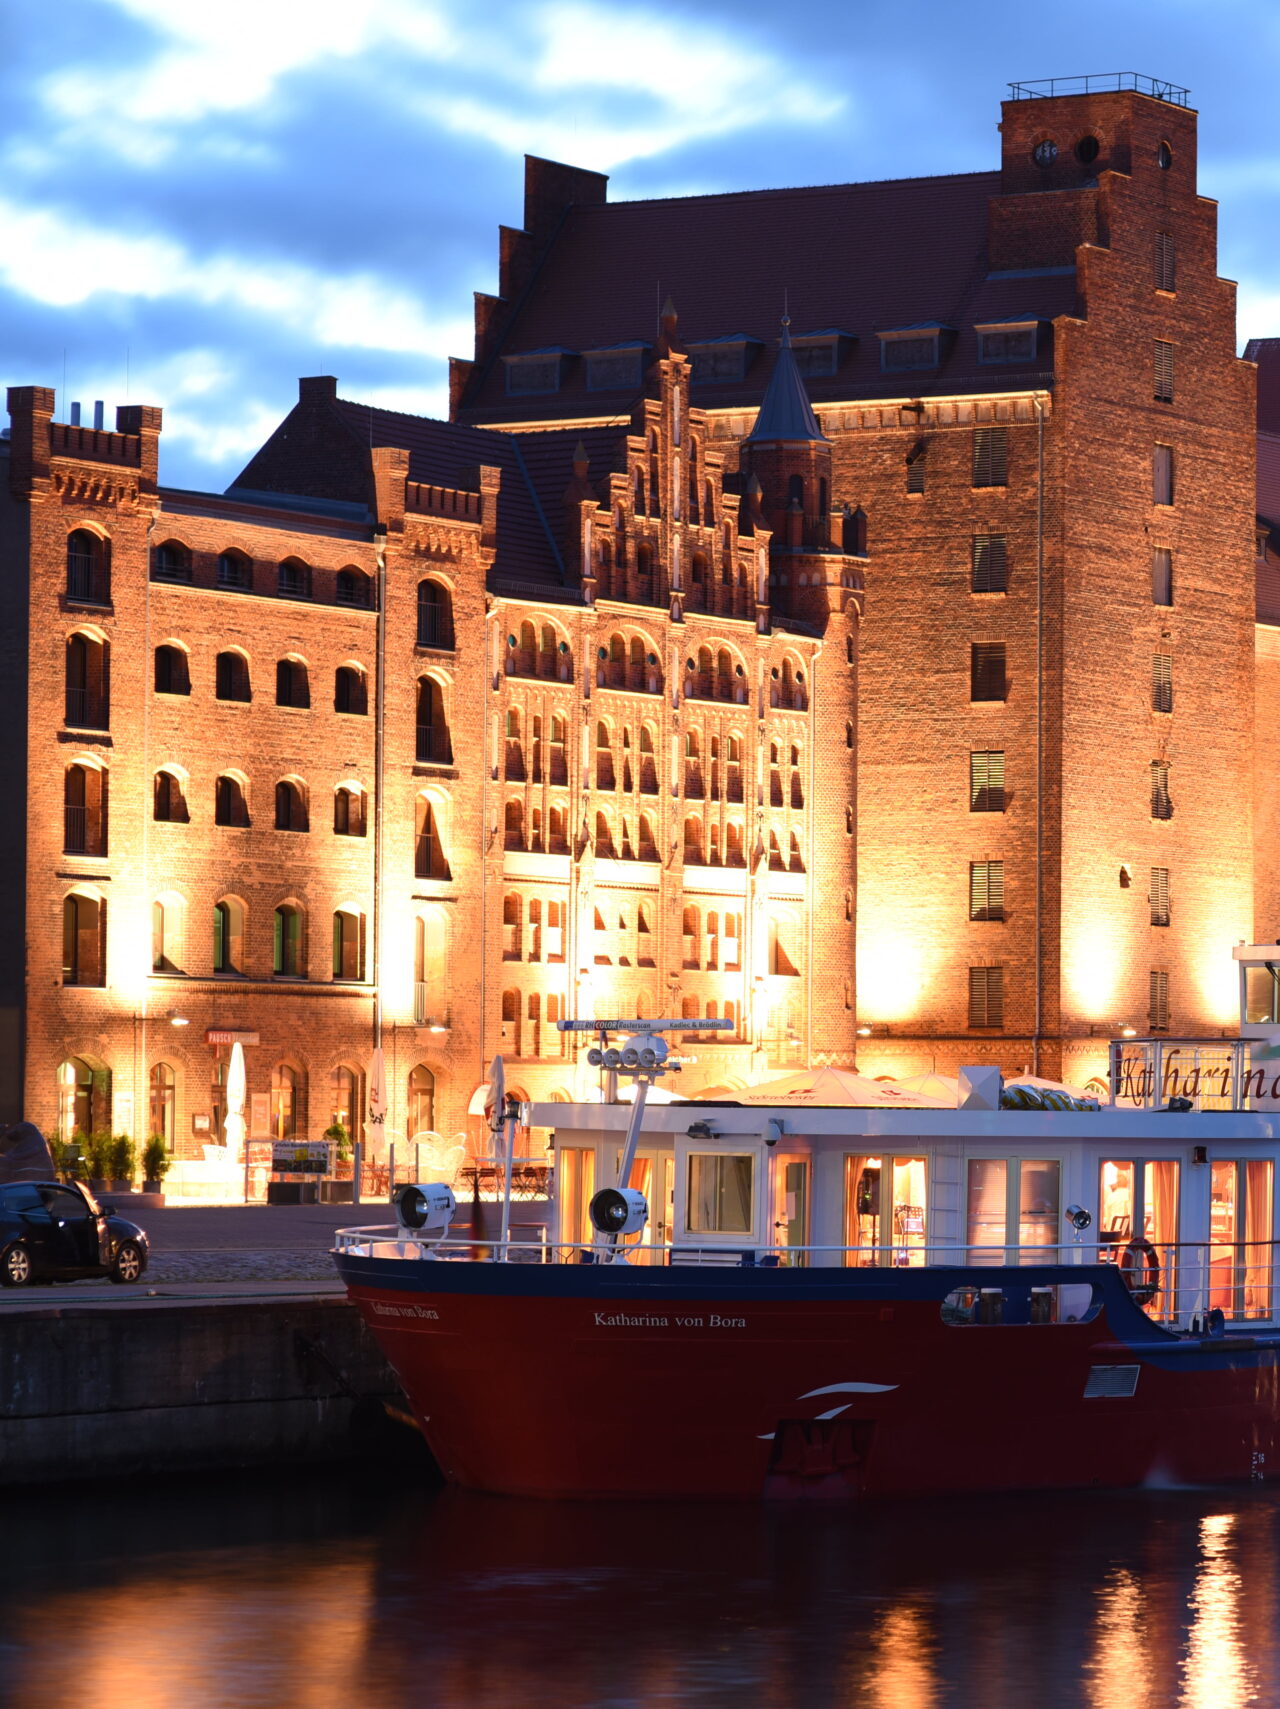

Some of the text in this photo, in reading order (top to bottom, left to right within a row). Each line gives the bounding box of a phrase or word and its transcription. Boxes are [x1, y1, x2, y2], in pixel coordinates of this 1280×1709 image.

[595, 1020, 618, 1030] COLOR
[669, 1020, 691, 1029] Kadlec
[692, 1021, 697, 1029] &
[415, 1305, 439, 1320] Bora
[594, 1312, 746, 1328] Katharina von Bora
